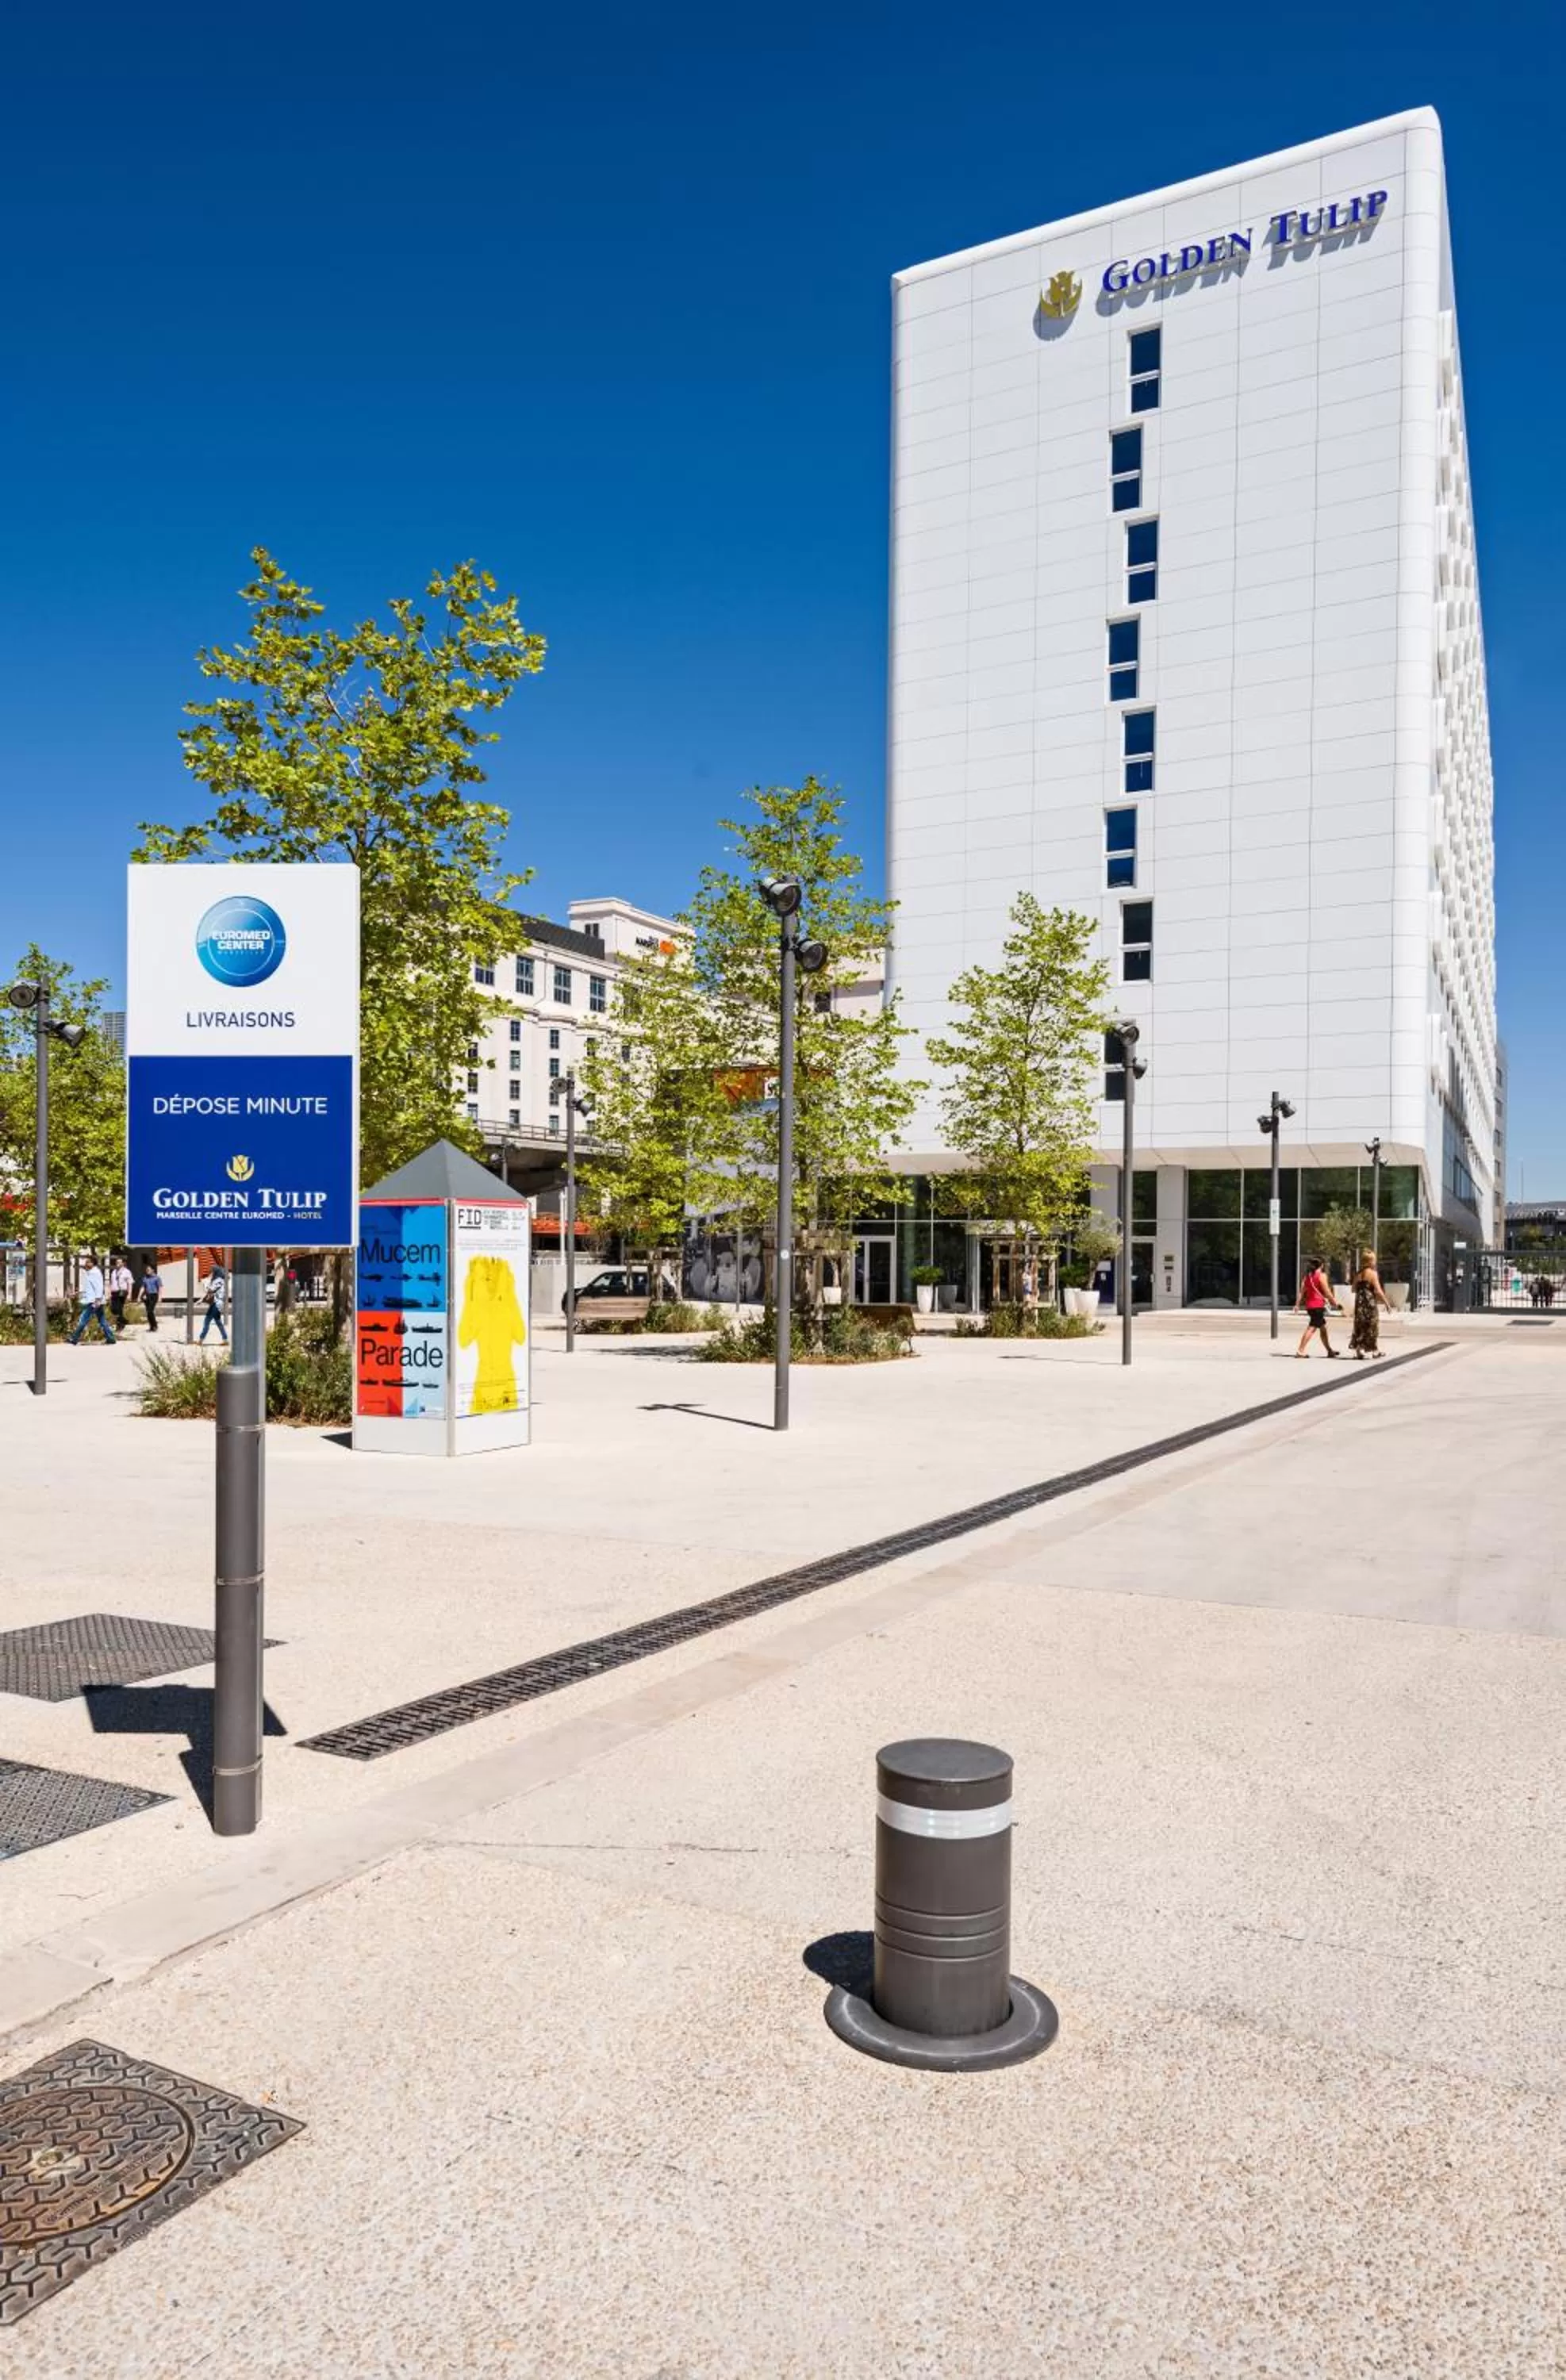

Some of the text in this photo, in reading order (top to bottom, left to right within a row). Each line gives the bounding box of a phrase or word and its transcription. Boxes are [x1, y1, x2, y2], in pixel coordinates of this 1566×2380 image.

[1102, 190, 1388, 292] GOLDEN TULIP
[212, 931, 271, 940] EUROMED
[217, 941, 264, 950] CENTER
[186, 1012, 295, 1027] LIVRAISONS
[153, 1093, 328, 1114] DÉPOSE MINUTE
[152, 1188, 327, 1208] GOLDEN TULIP
[458, 1208, 482, 1225] FID
[360, 1238, 441, 1264] Mucem
[361, 1338, 443, 1368] Parade
